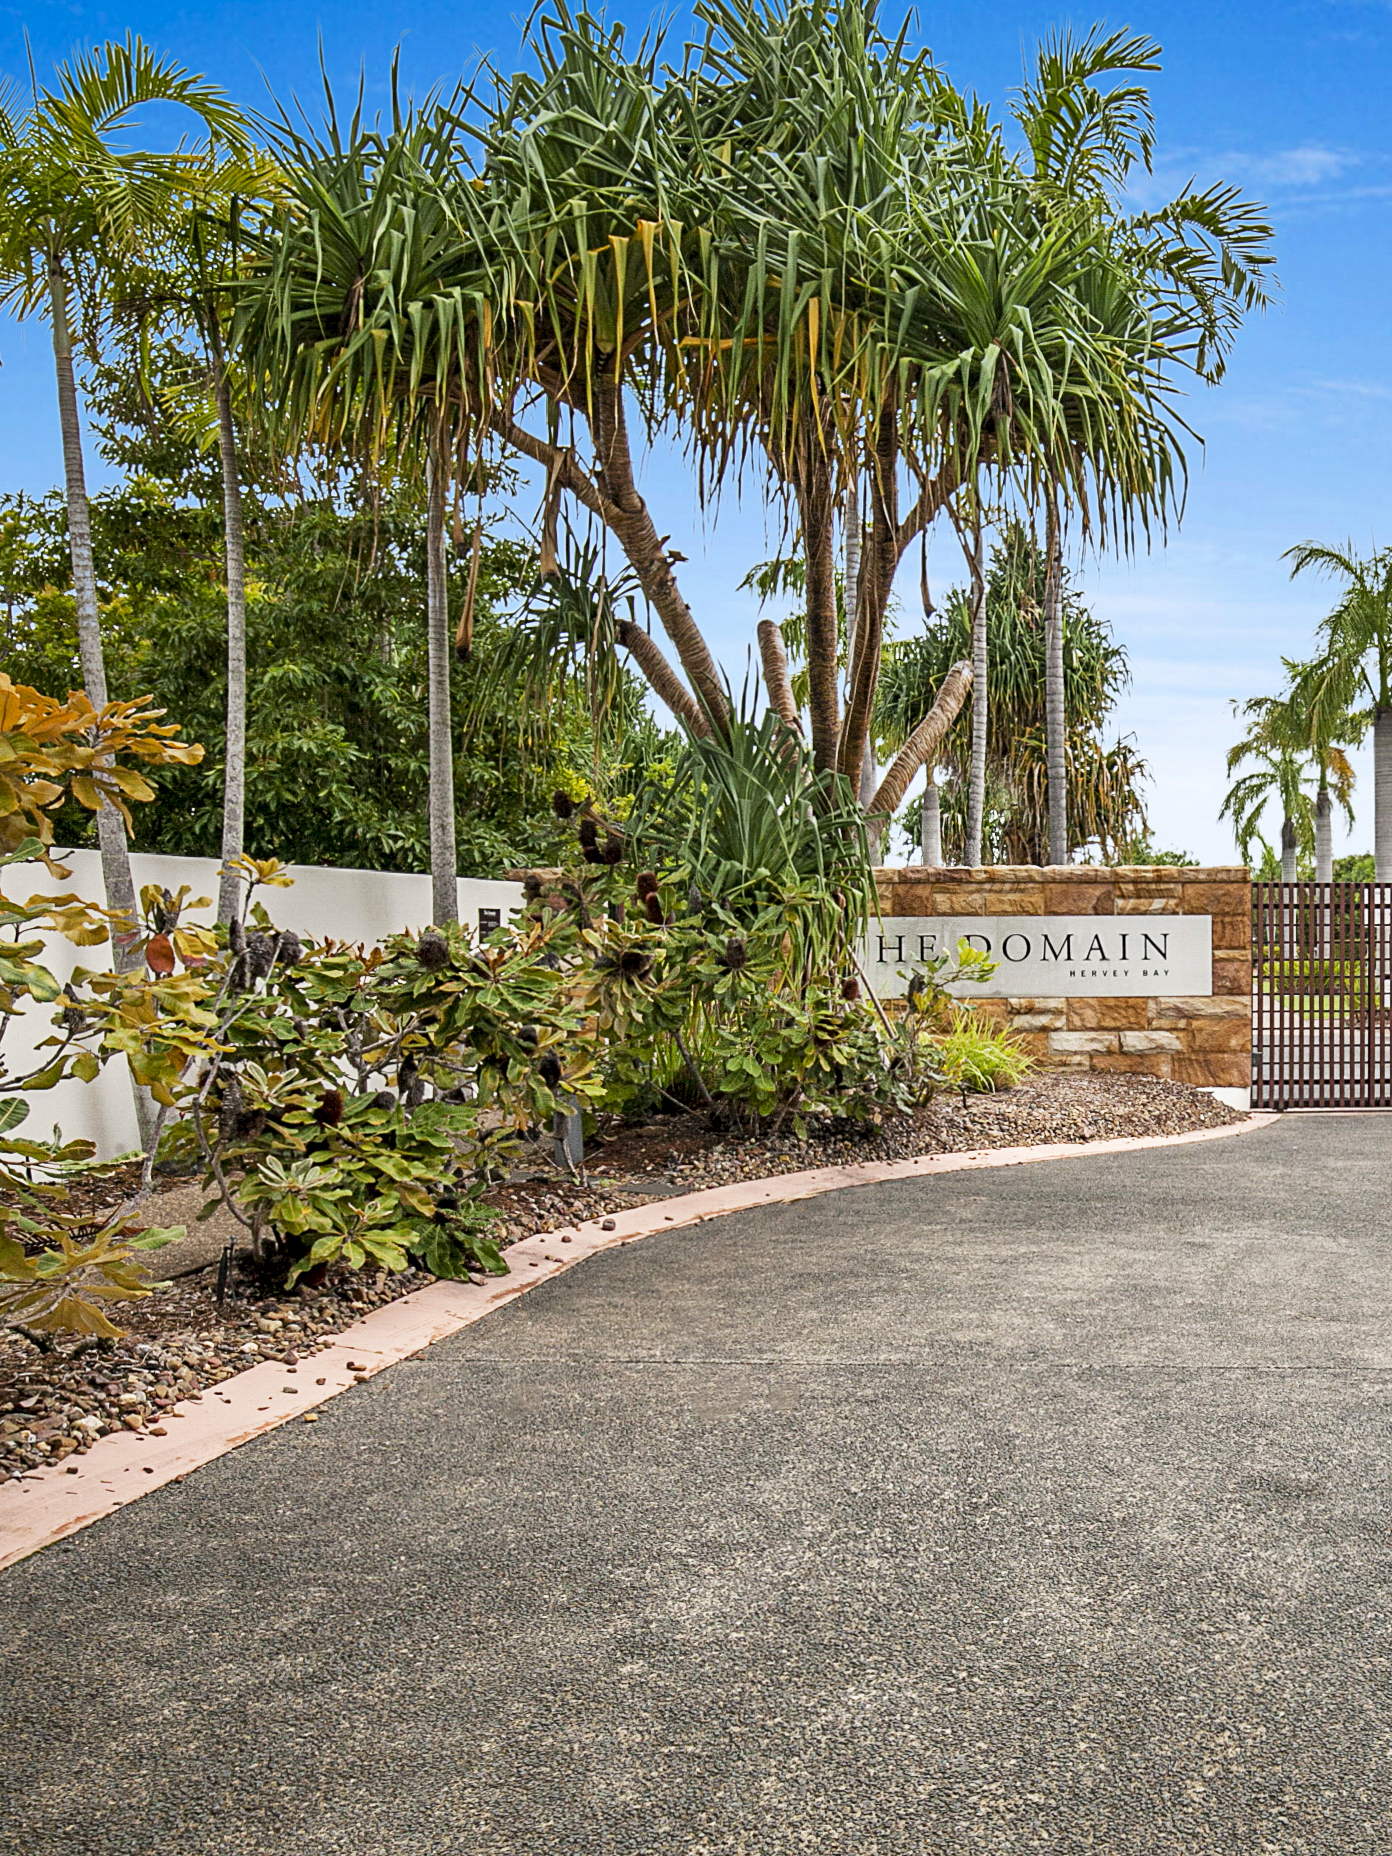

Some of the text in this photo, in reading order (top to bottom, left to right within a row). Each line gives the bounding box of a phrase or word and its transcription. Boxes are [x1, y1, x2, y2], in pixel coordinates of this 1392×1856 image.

[856, 933, 1170, 963] HE DOMAIN
[1069, 969, 1170, 978] HERVEY BAY
